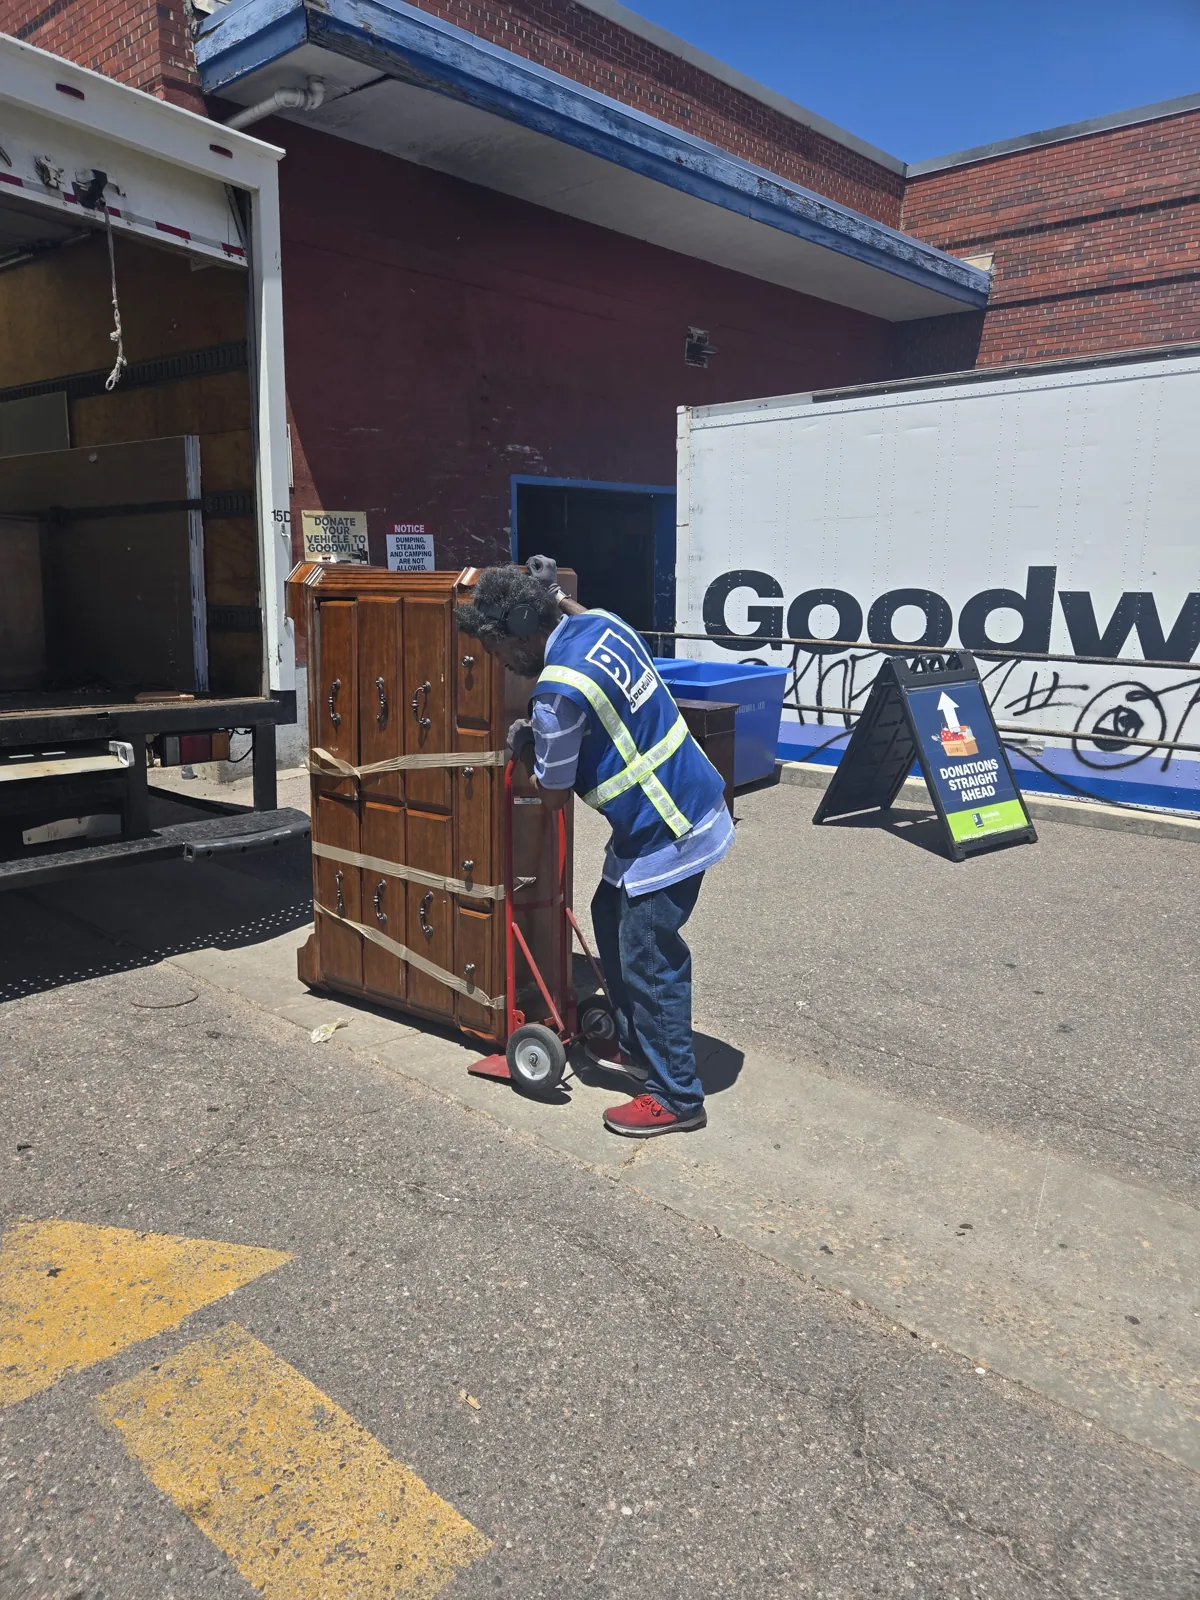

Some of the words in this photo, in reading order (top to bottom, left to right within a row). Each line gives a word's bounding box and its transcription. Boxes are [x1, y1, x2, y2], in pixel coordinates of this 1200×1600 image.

[314, 516, 356, 527] DONATE
[321, 526, 350, 535] YOUR
[394, 524, 425, 533] NOTICE
[306, 535, 349, 544] VEHICLE
[352, 535, 366, 544] TO
[412, 557, 424, 565] NOT
[940, 759, 999, 780] DONATIONS
[948, 771, 998, 791] STRAIGHT
[961, 785, 996, 802] AHEAD
